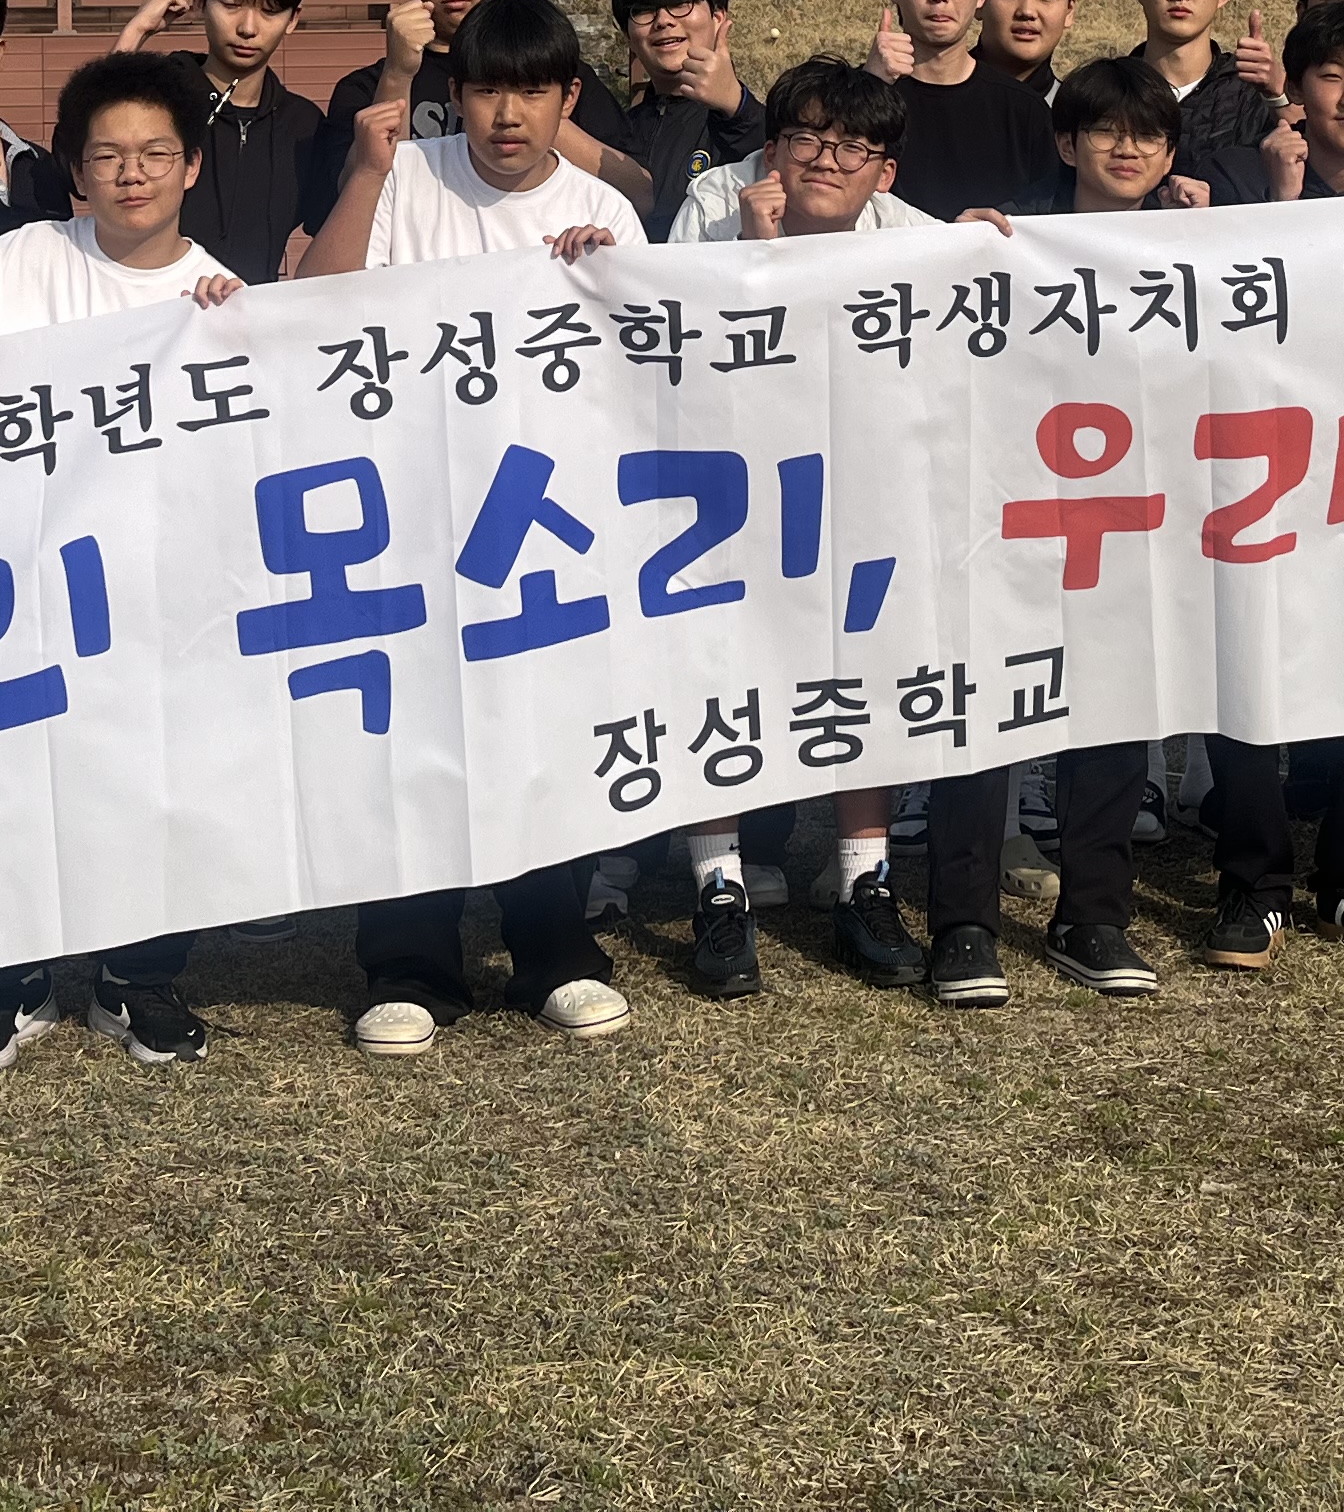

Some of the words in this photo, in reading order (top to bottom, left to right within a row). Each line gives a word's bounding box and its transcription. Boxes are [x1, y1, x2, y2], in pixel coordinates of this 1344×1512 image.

[316, 299, 797, 420] 장성중학교
[842, 257, 1288, 369] 학생자치회
[236, 445, 896, 735] 목소리,
[593, 645, 1070, 813] 장성중학교
